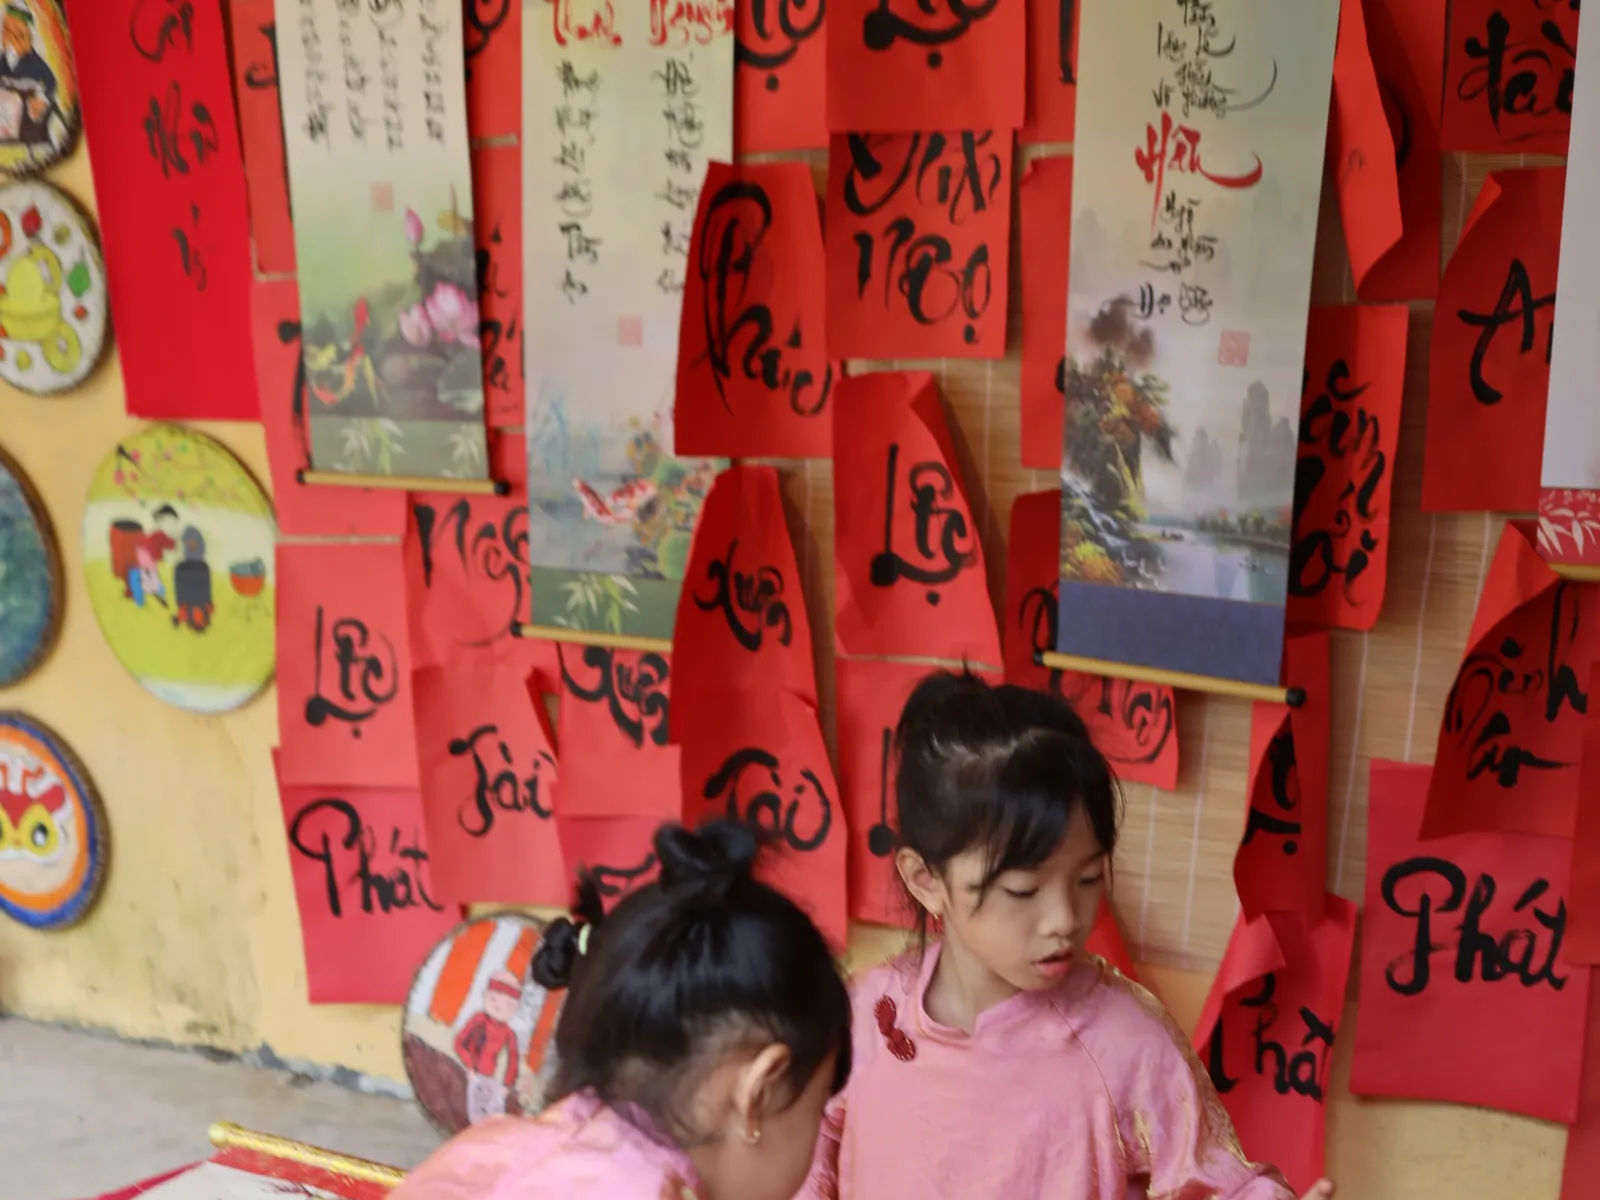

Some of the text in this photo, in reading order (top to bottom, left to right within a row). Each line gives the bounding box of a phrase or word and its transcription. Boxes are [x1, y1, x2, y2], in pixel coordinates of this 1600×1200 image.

[1457, 258, 1557, 406] A
[867, 442, 978, 607] Lộc
[304, 605, 398, 738] Lộc
[448, 722, 557, 838] Tài
[289, 797, 445, 917] Phát
[1381, 856, 1569, 996] Phát
